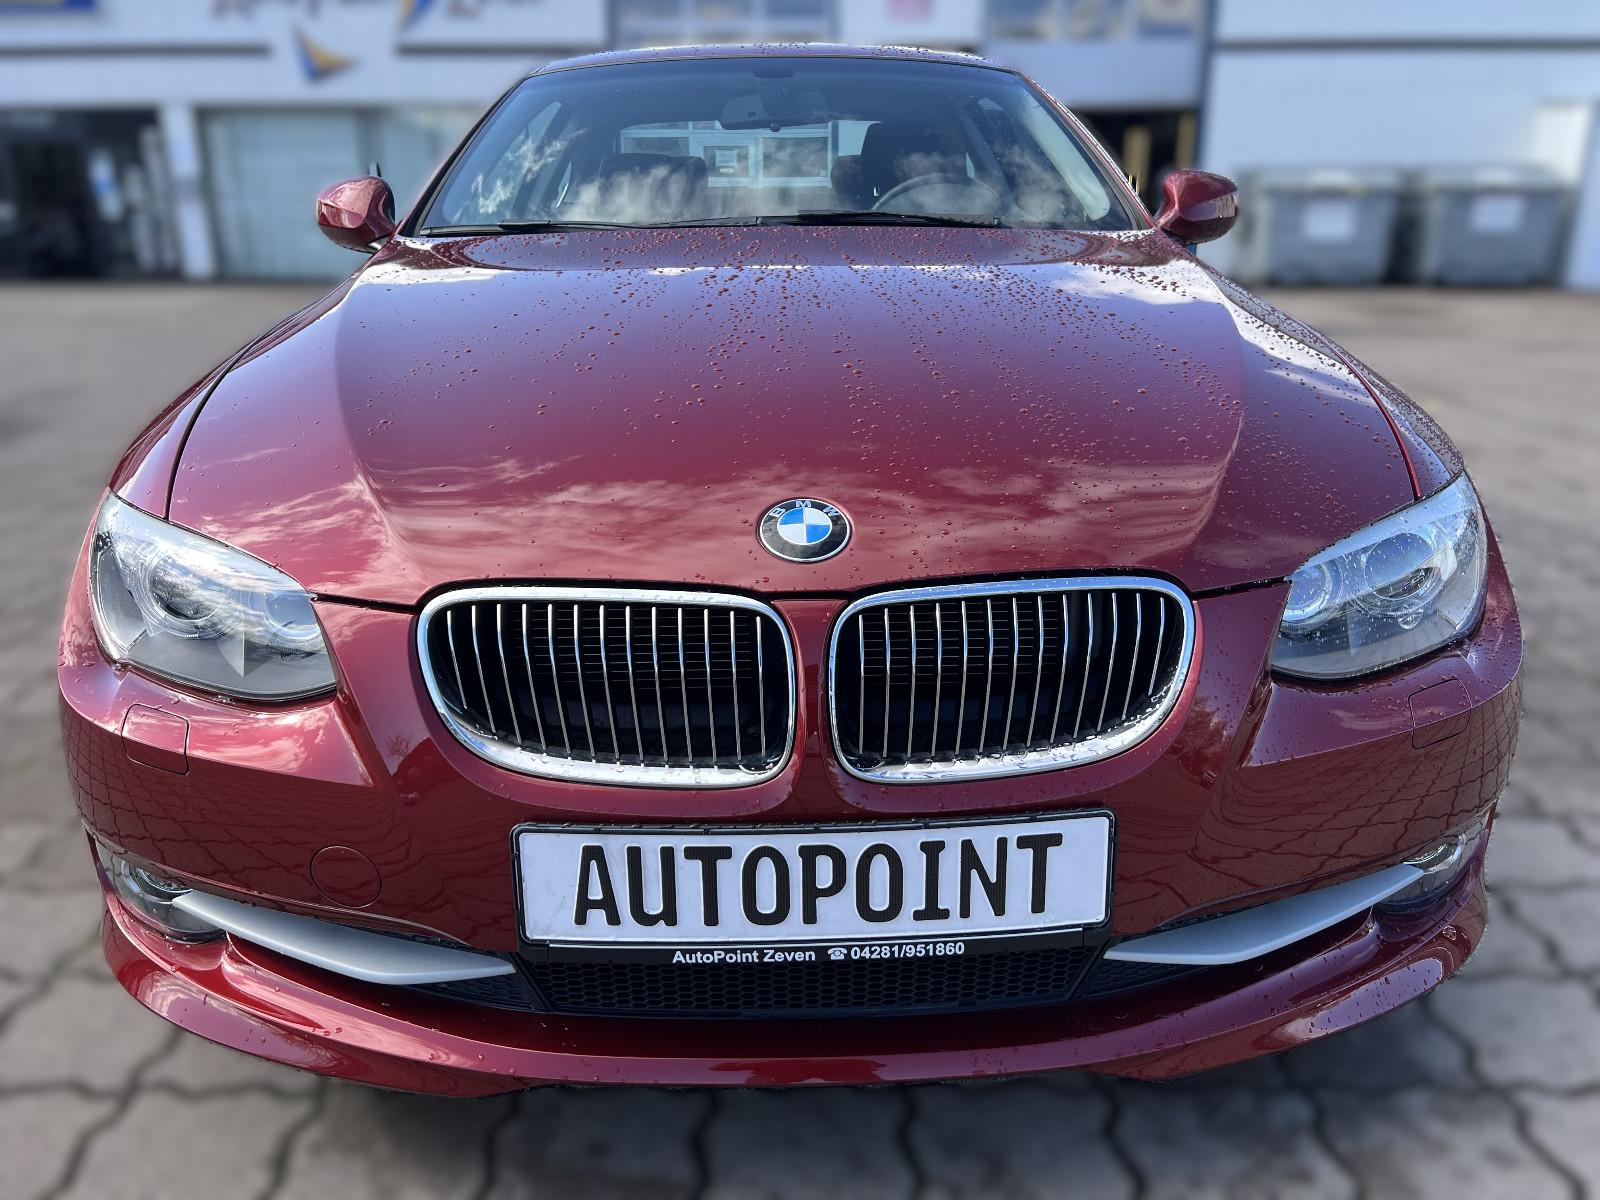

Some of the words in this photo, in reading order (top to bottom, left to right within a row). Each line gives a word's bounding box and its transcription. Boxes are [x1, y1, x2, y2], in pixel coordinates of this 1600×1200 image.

[769, 500, 840, 517] BMW
[574, 833, 1063, 927] AUTOPOINT
[672, 950, 758, 964] AutoPoint
[763, 949, 816, 962] Zeven
[850, 942, 965, 960] 04281/951860
